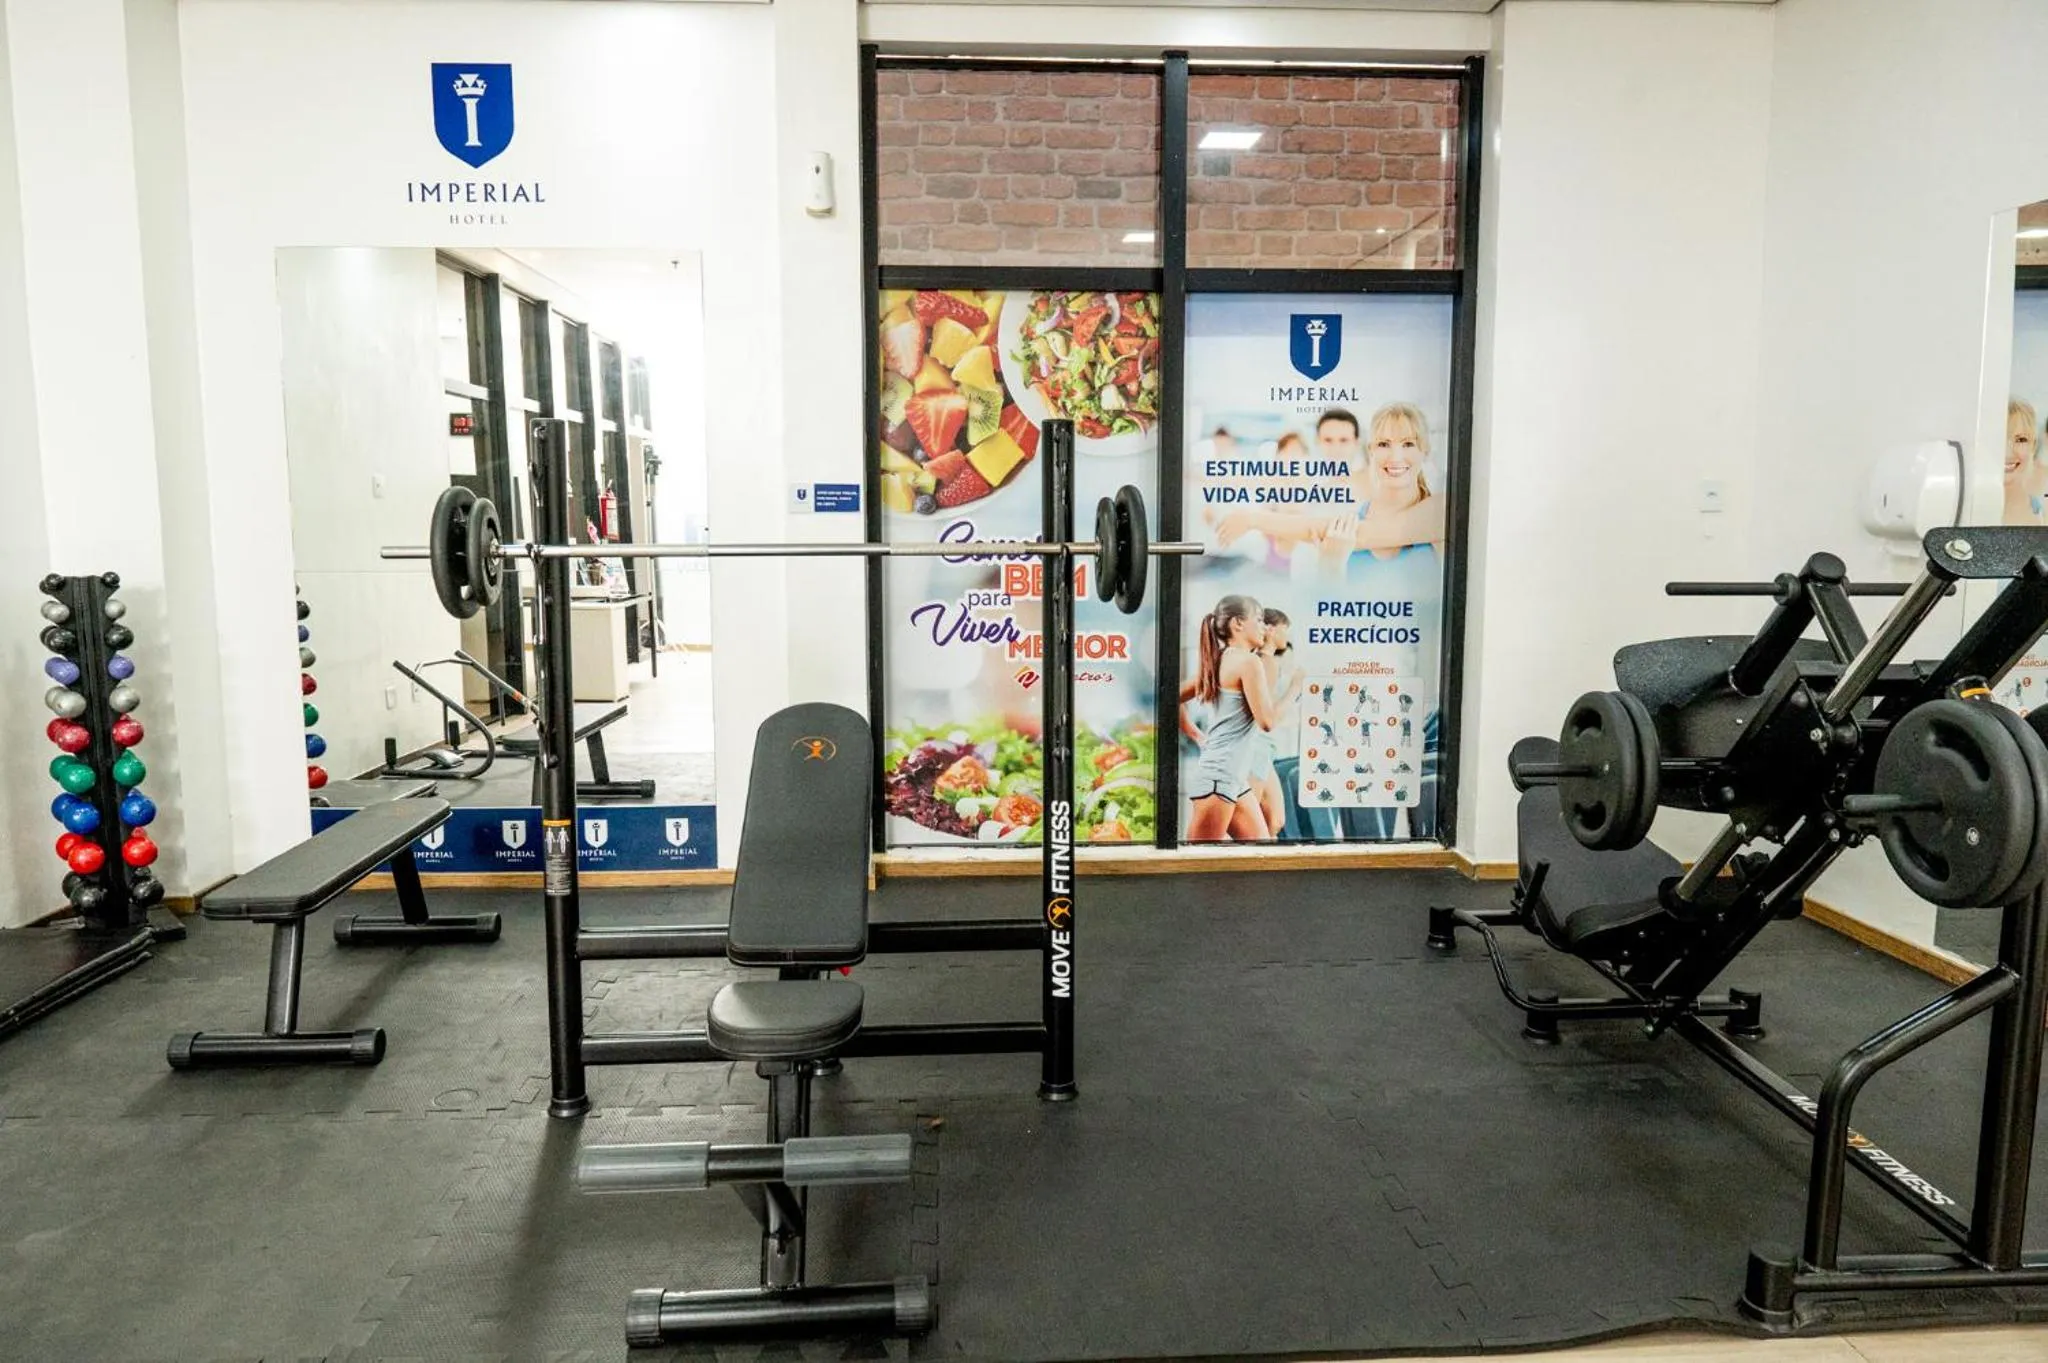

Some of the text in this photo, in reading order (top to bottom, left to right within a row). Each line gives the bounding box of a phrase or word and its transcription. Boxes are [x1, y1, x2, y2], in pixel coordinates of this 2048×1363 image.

[407, 182, 546, 202] IMPERIAL
[449, 214, 508, 225] HOTEL
[1270, 387, 1359, 401] IMPERIAL
[1206, 461, 1350, 477] ESTIMULE UMA
[1203, 484, 1355, 503] VIDA SAUDÁVEL
[968, 592, 1011, 610] para
[1317, 602, 1413, 619] PRATIQUE
[911, 603, 1020, 647] Viver
[1309, 625, 1420, 644] EXERCÍCIOS
[1051, 801, 1071, 998] MOVE FITNESS
[1859, 1149, 1955, 1205] FITNESS
